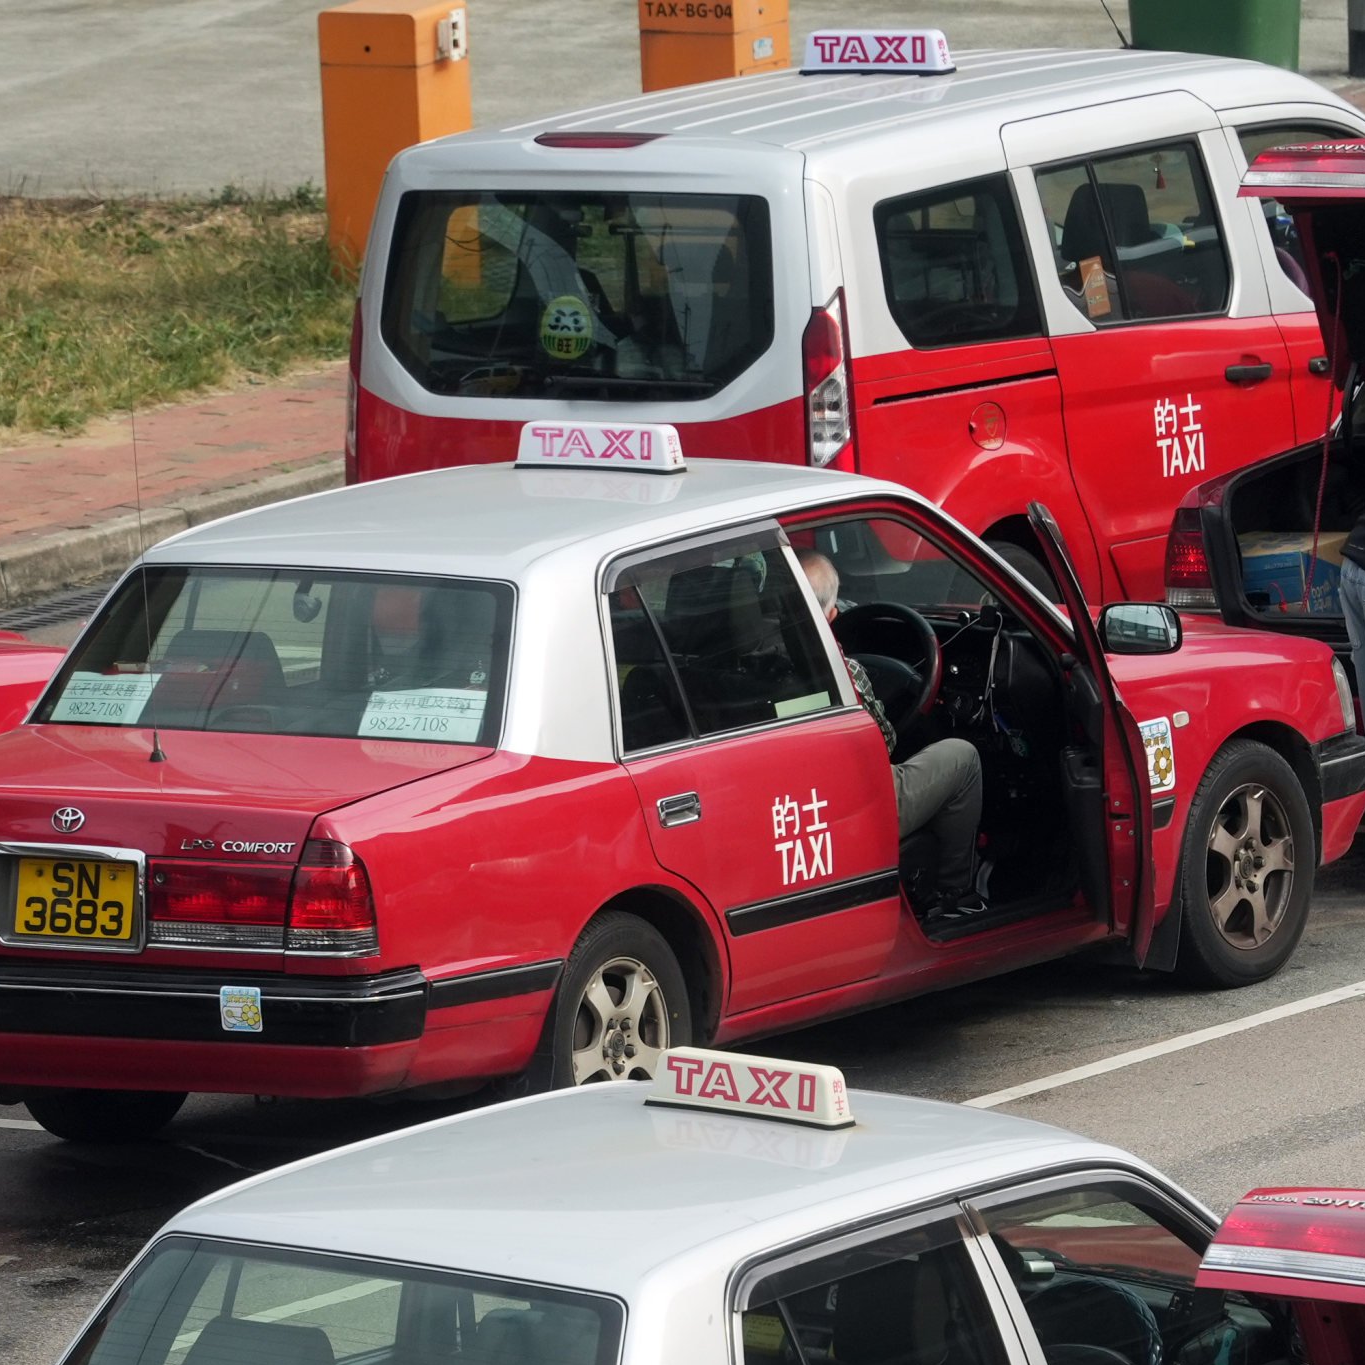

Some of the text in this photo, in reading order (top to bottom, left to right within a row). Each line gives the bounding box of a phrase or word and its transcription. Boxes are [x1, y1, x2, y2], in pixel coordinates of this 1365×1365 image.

[644, 1, 733, 19] TAX-BG-04
[813, 36, 927, 64] TAXI
[557, 337, 571, 353] 旺
[1154, 393, 1202, 437] 的士
[532, 427, 651, 460] TAXI
[1156, 432, 1206, 478] TAXI
[67, 702, 125, 716] 9822-7108
[369, 716, 449, 733] 9822-7108
[771, 788, 828, 839] 的士
[180, 839, 297, 855] LPG COMFORT
[775, 831, 833, 885] TAXI
[51, 862, 101, 899] SN
[24, 896, 124, 936] 3683
[666, 1056, 815, 1112] TAXI
